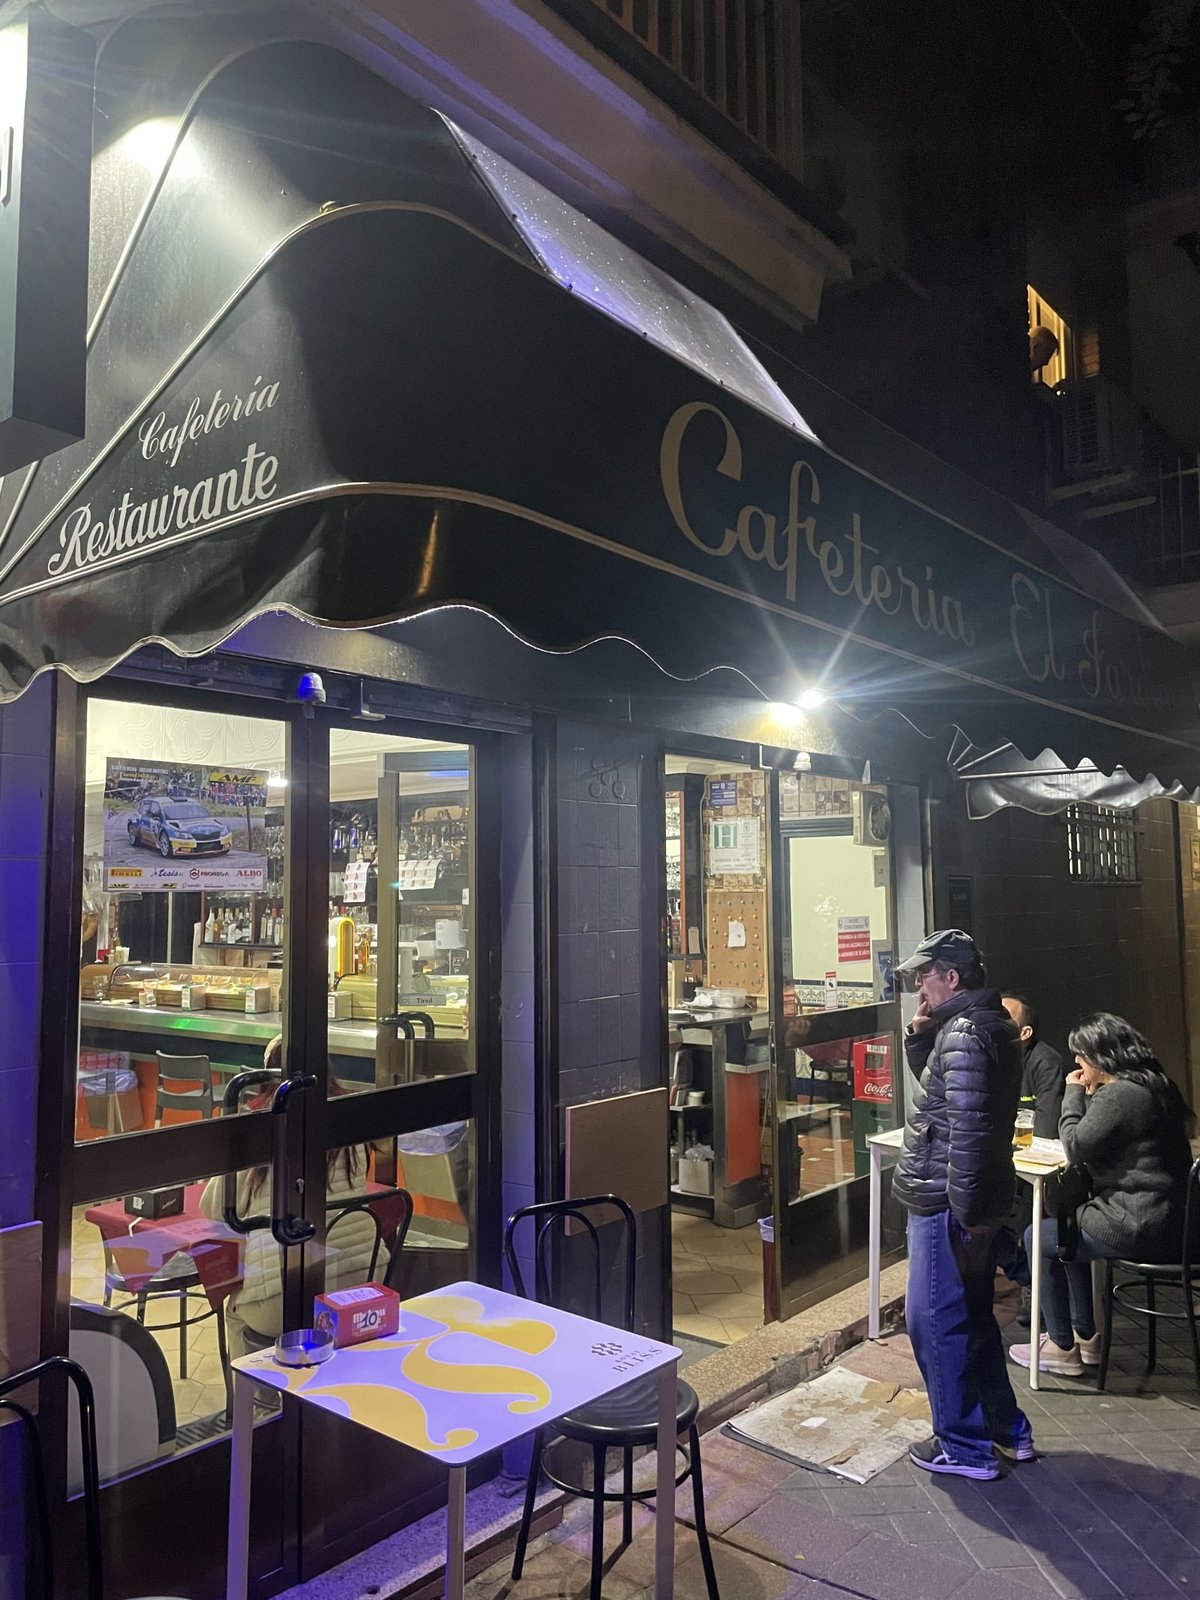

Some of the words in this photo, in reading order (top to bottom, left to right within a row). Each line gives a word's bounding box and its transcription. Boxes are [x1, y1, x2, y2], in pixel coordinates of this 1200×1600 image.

[138, 375, 280, 468] Cafetería
[47, 442, 279, 577] Restaurante
[1010, 571, 1065, 683] El
[111, 869, 142, 877] PIRELLI
[361, 1311, 378, 1329] 10
[612, 1346, 663, 1373] BLISS
